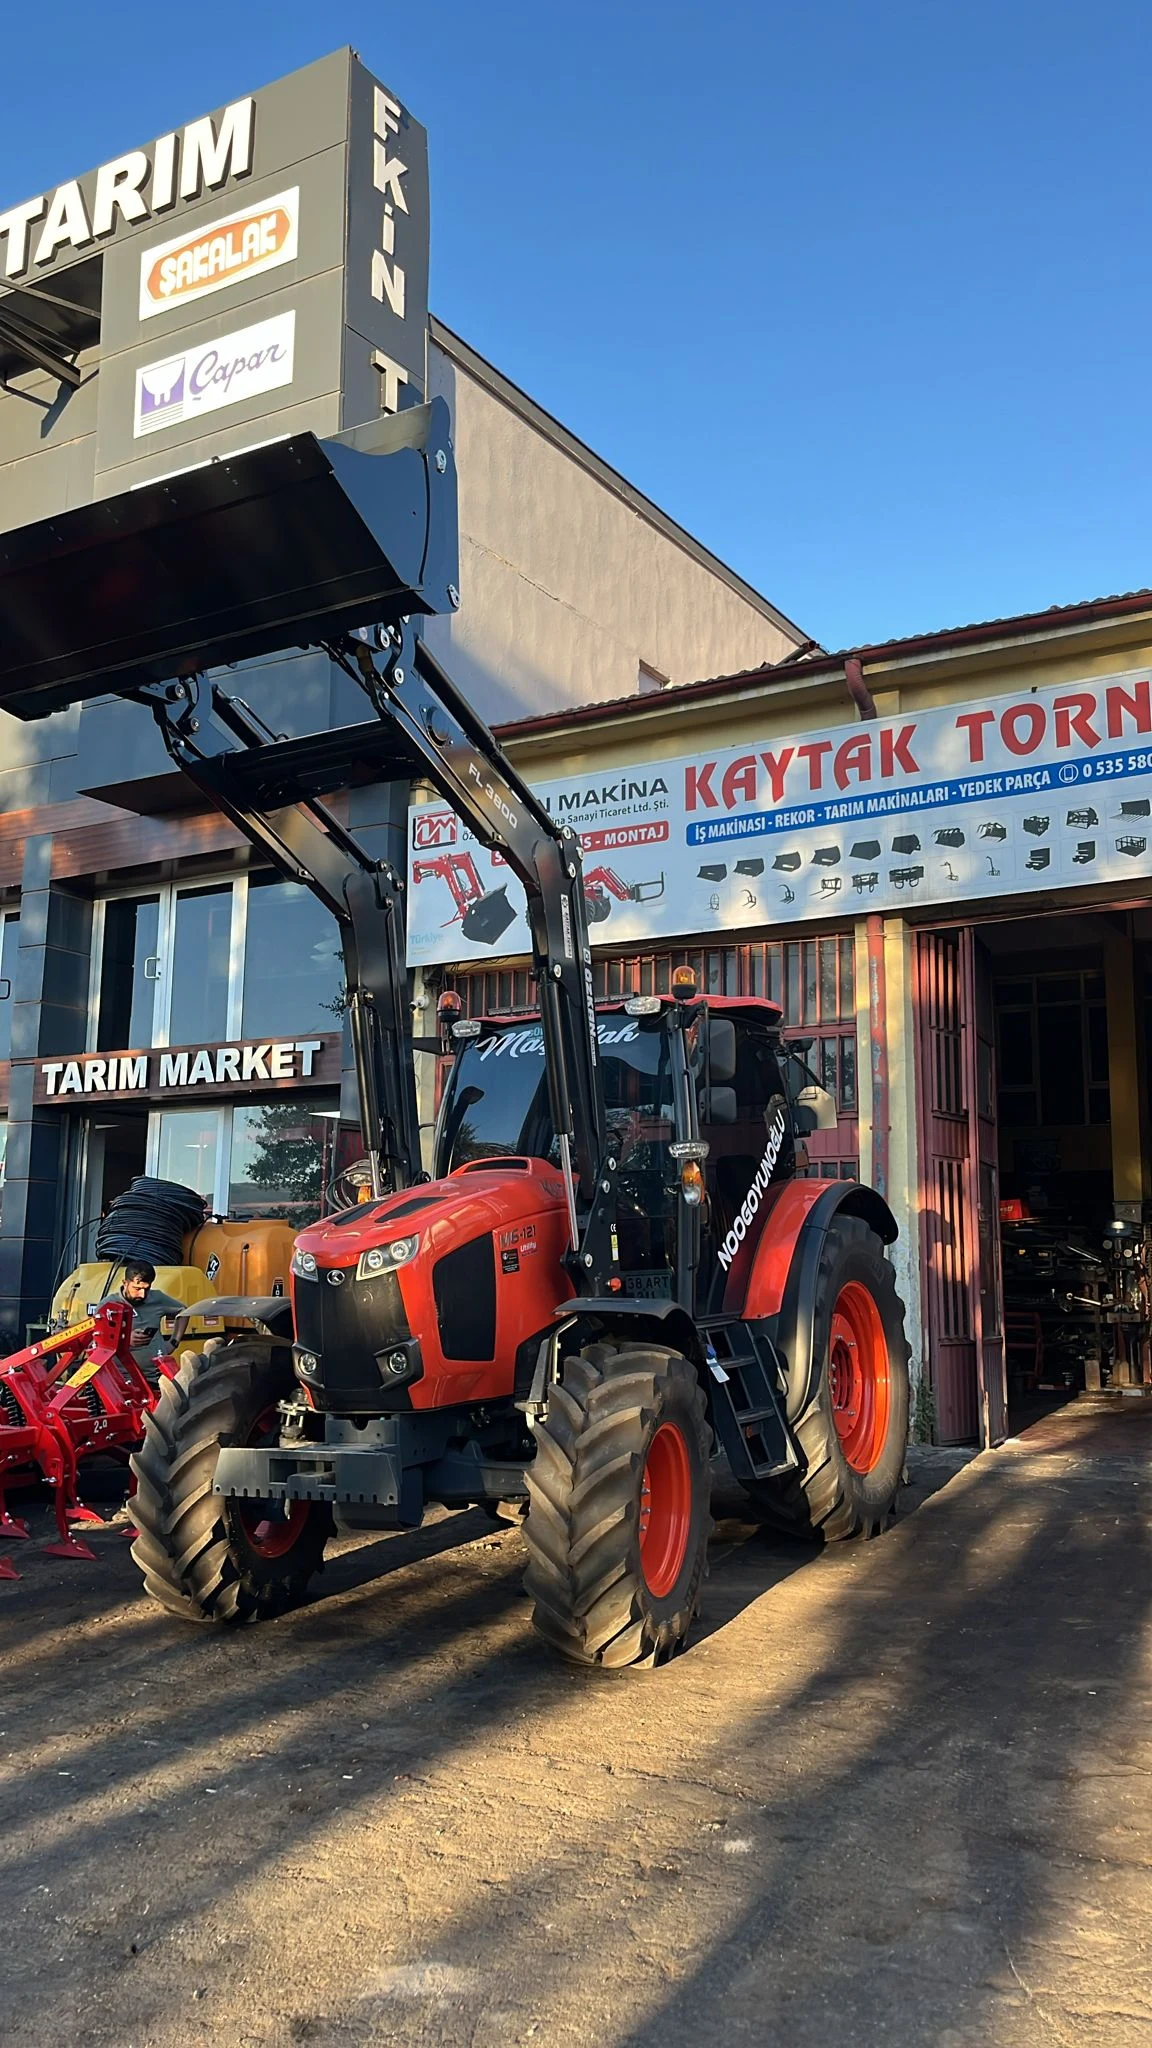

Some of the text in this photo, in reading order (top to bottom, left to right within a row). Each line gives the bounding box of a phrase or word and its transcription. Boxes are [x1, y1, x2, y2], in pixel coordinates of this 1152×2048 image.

[0, 97, 254, 279] TARIM
[159, 213, 277, 297] ŞAKALAK
[685, 681, 1152, 811] KAYTAK TORN
[468, 762, 483, 788] FL
[485, 783, 518, 829] 3800
[558, 778, 669, 811] MAKİNA
[567, 810, 598, 823] Sanayi
[599, 806, 631, 818] Ticaret
[633, 804, 652, 813] Ltd.
[653, 799, 669, 812] Şti.
[695, 824, 706, 842] İŞ
[708, 816, 766, 839] MAKİNASI
[775, 809, 815, 828] REKOR
[824, 800, 865, 820] TARIM
[866, 787, 949, 813] MAKİNALARI
[958, 777, 1003, 798] YEDEK
[1005, 770, 1051, 791] PARÇA
[1082, 764, 1093, 778] 0
[1096, 758, 1124, 776] 535
[604, 825, 665, 846] MONTAJ
[41, 1040, 321, 1095] TARIM MARKET
[646, 1276, 669, 1289] ART
